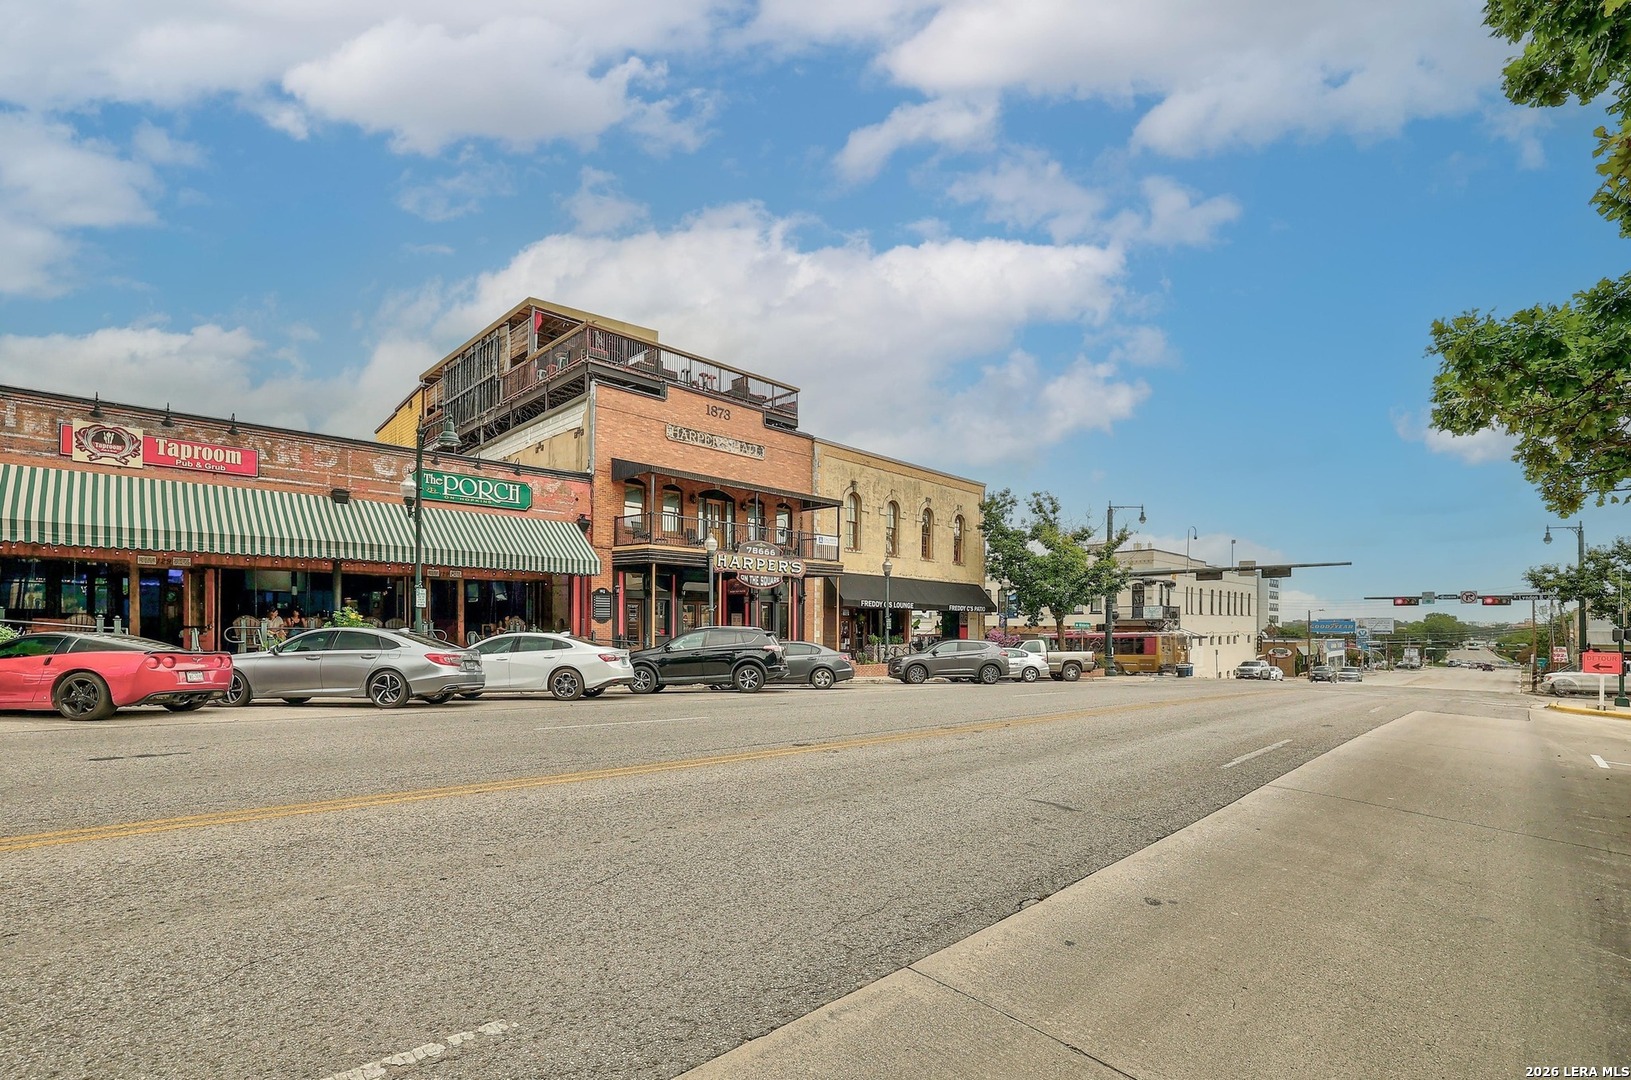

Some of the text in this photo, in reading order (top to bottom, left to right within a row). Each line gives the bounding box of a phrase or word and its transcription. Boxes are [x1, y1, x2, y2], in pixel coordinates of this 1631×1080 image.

[705, 404, 731, 421] 1873
[95, 442, 122, 451] Taproom
[155, 438, 242, 465] Taproom
[175, 459, 227, 472] Pub & Grub
[423, 472, 521, 504] The PORCH
[746, 546, 776, 556] 78666
[717, 554, 802, 574] HARPER'S
[740, 574, 780, 587] ON THE SQUARE
[860, 600, 883, 608] FREDDY
